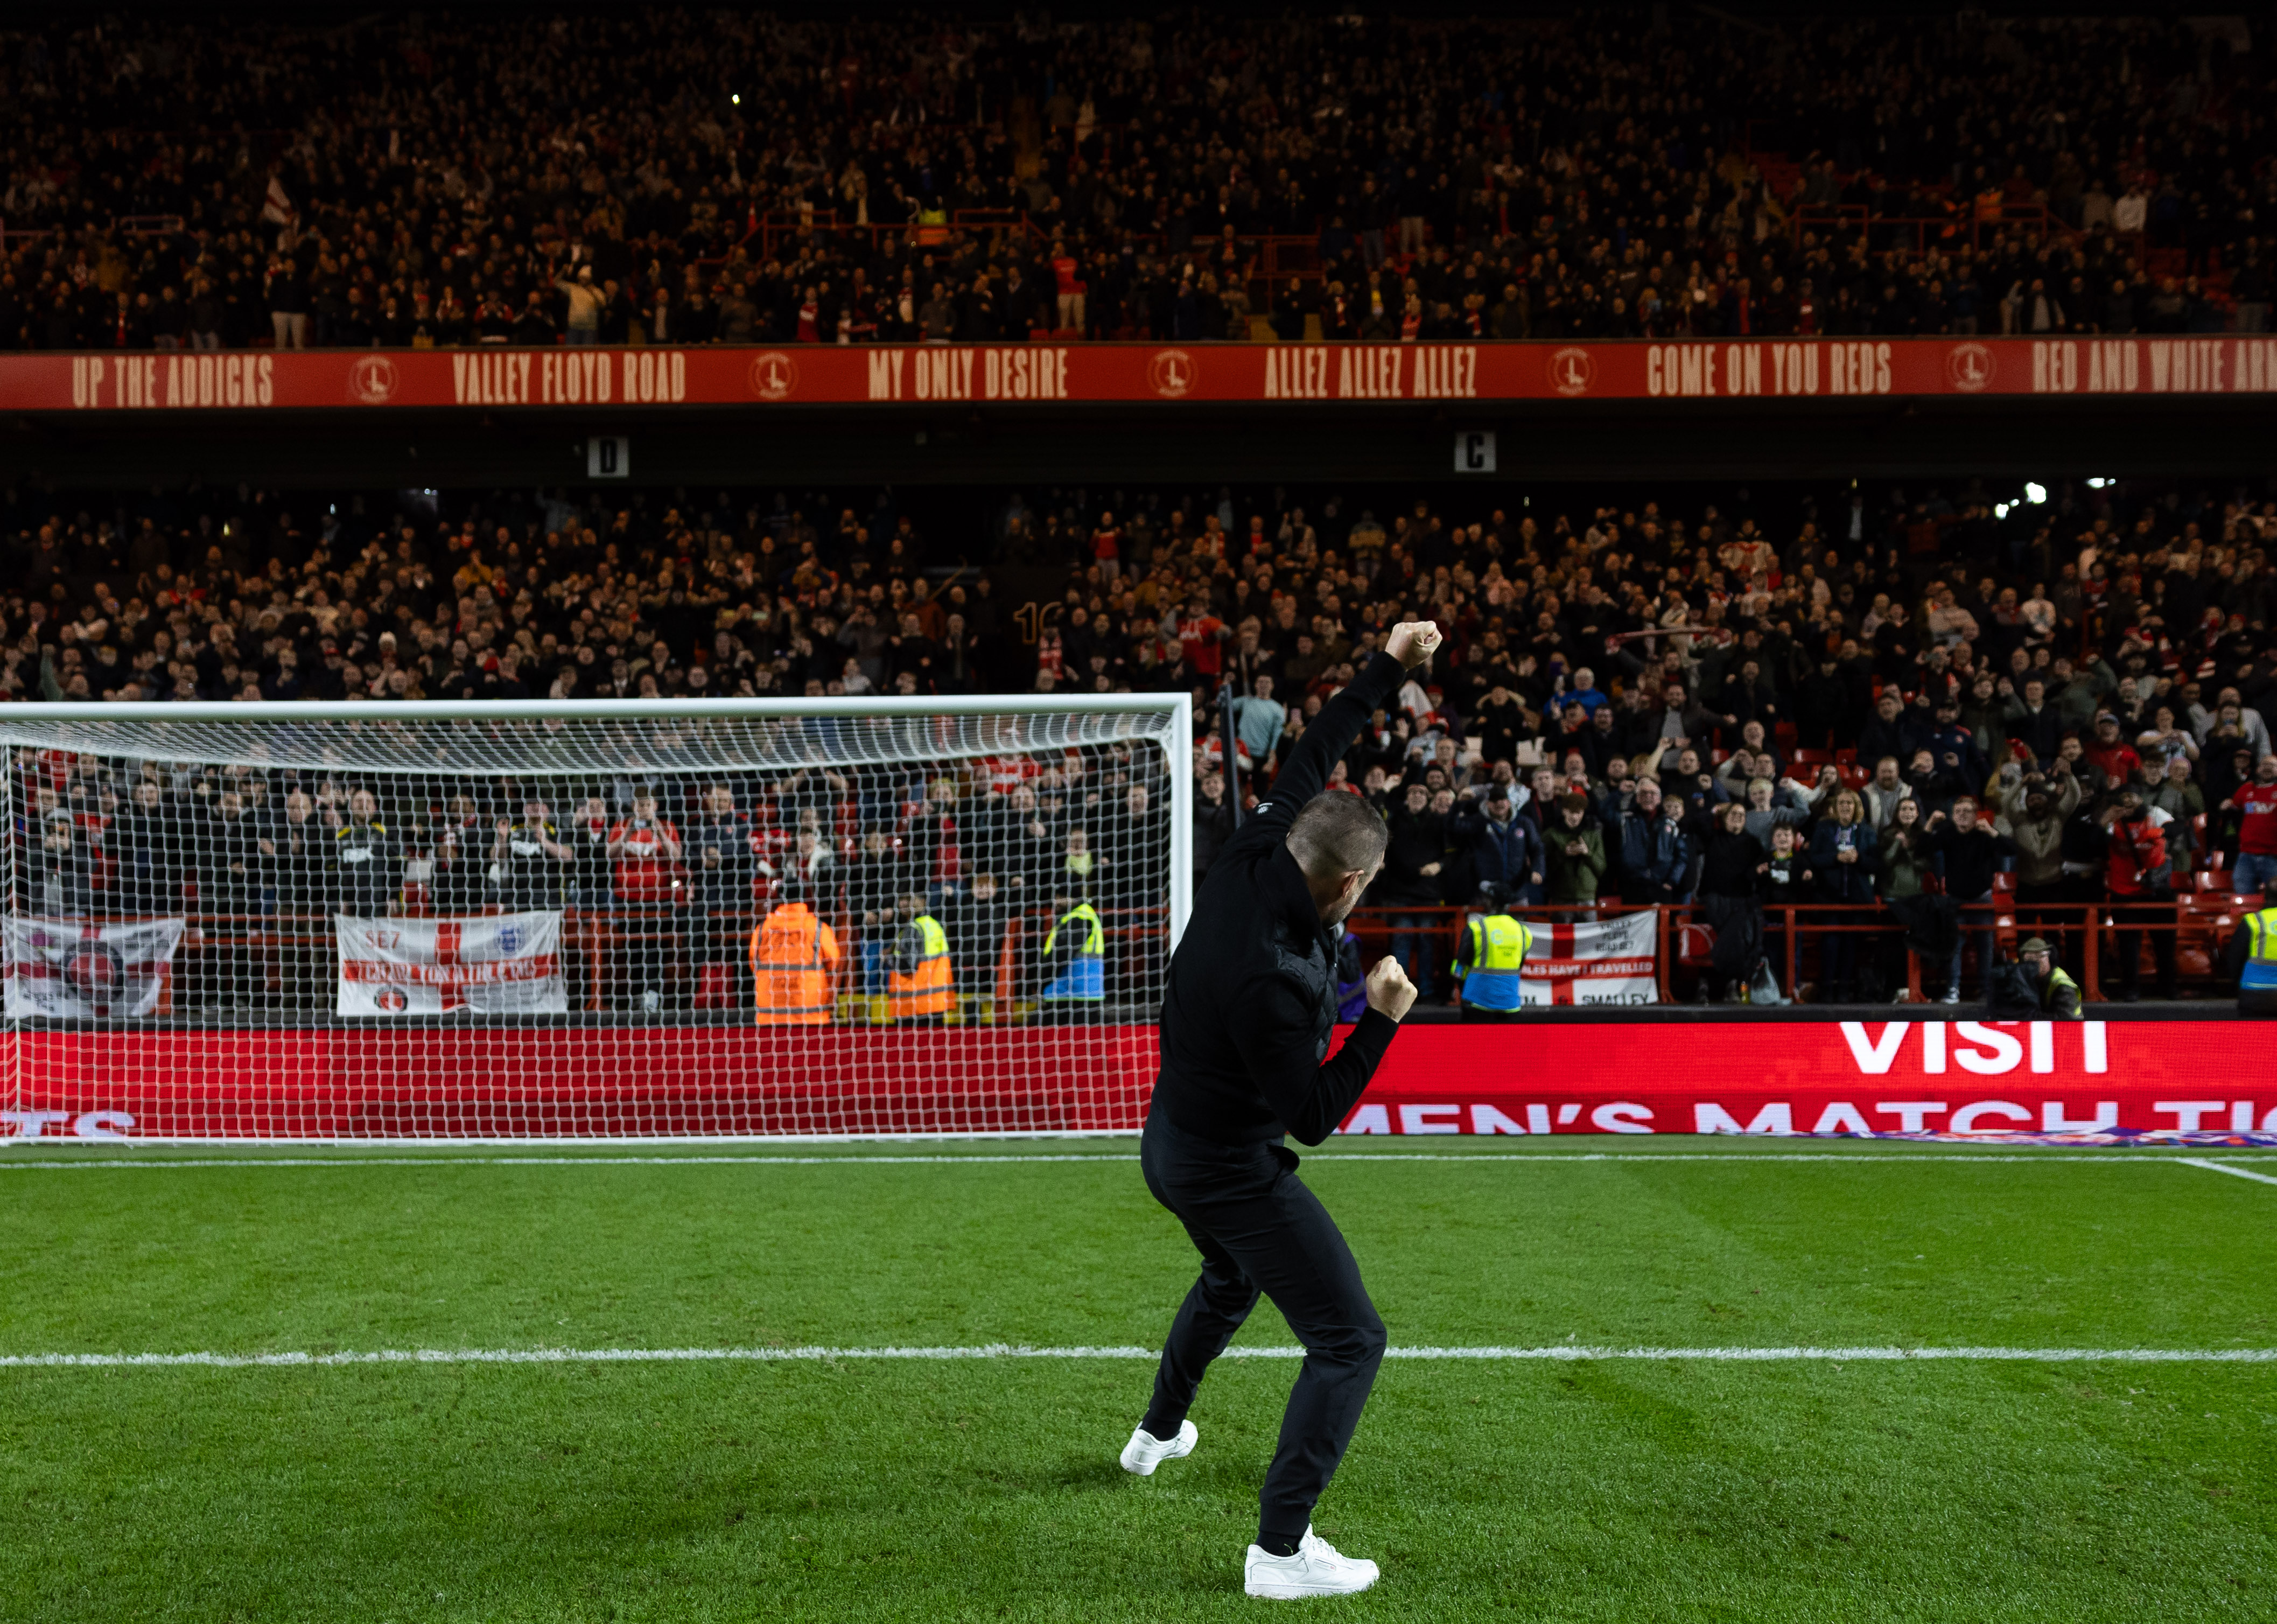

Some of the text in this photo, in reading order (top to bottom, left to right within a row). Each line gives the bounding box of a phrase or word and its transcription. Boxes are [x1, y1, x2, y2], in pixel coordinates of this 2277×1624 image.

[73, 355, 273, 408] UP THE ADDICKS
[453, 353, 531, 404] VALLEY
[542, 352, 611, 403] FLOYD
[623, 352, 685, 403] ROAD
[868, 348, 1068, 400] MY ONLY DESIRE
[1264, 346, 1477, 398] ALLEZ ALLEZ ALLEZ
[1647, 345, 1716, 396] COME
[1727, 344, 1761, 395] ON
[1772, 343, 1819, 395] YOU
[1830, 342, 1891, 394] REDS
[2032, 341, 2078, 392] RED
[2087, 341, 2139, 392] AND
[2149, 340, 2224, 392] WHITE
[600, 438, 617, 474] D
[1466, 433, 1484, 468] C
[2154, 1101, 2277, 1131] TI
